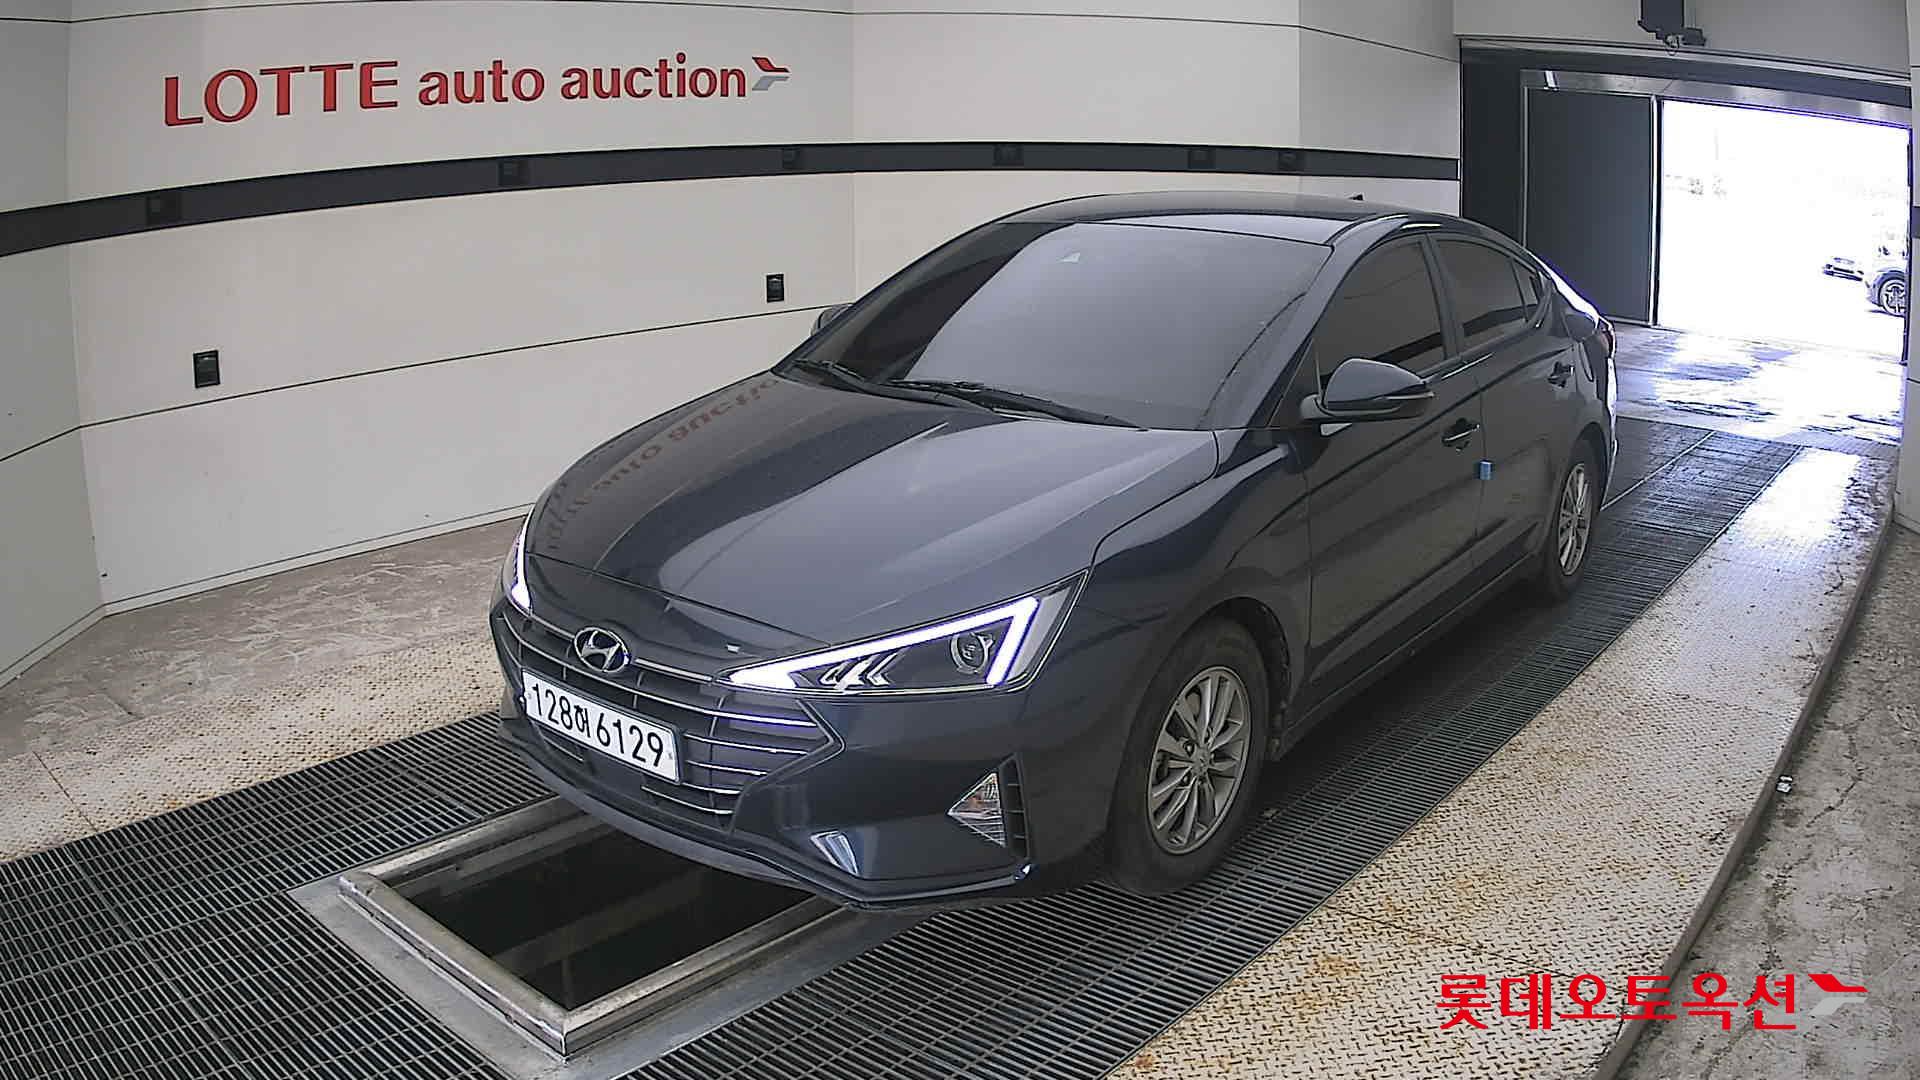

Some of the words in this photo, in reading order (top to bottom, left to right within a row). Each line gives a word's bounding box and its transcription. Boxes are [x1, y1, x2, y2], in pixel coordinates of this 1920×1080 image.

[165, 61, 398, 126] LOTTE
[419, 60, 545, 106] auto
[561, 52, 748, 100] auction
